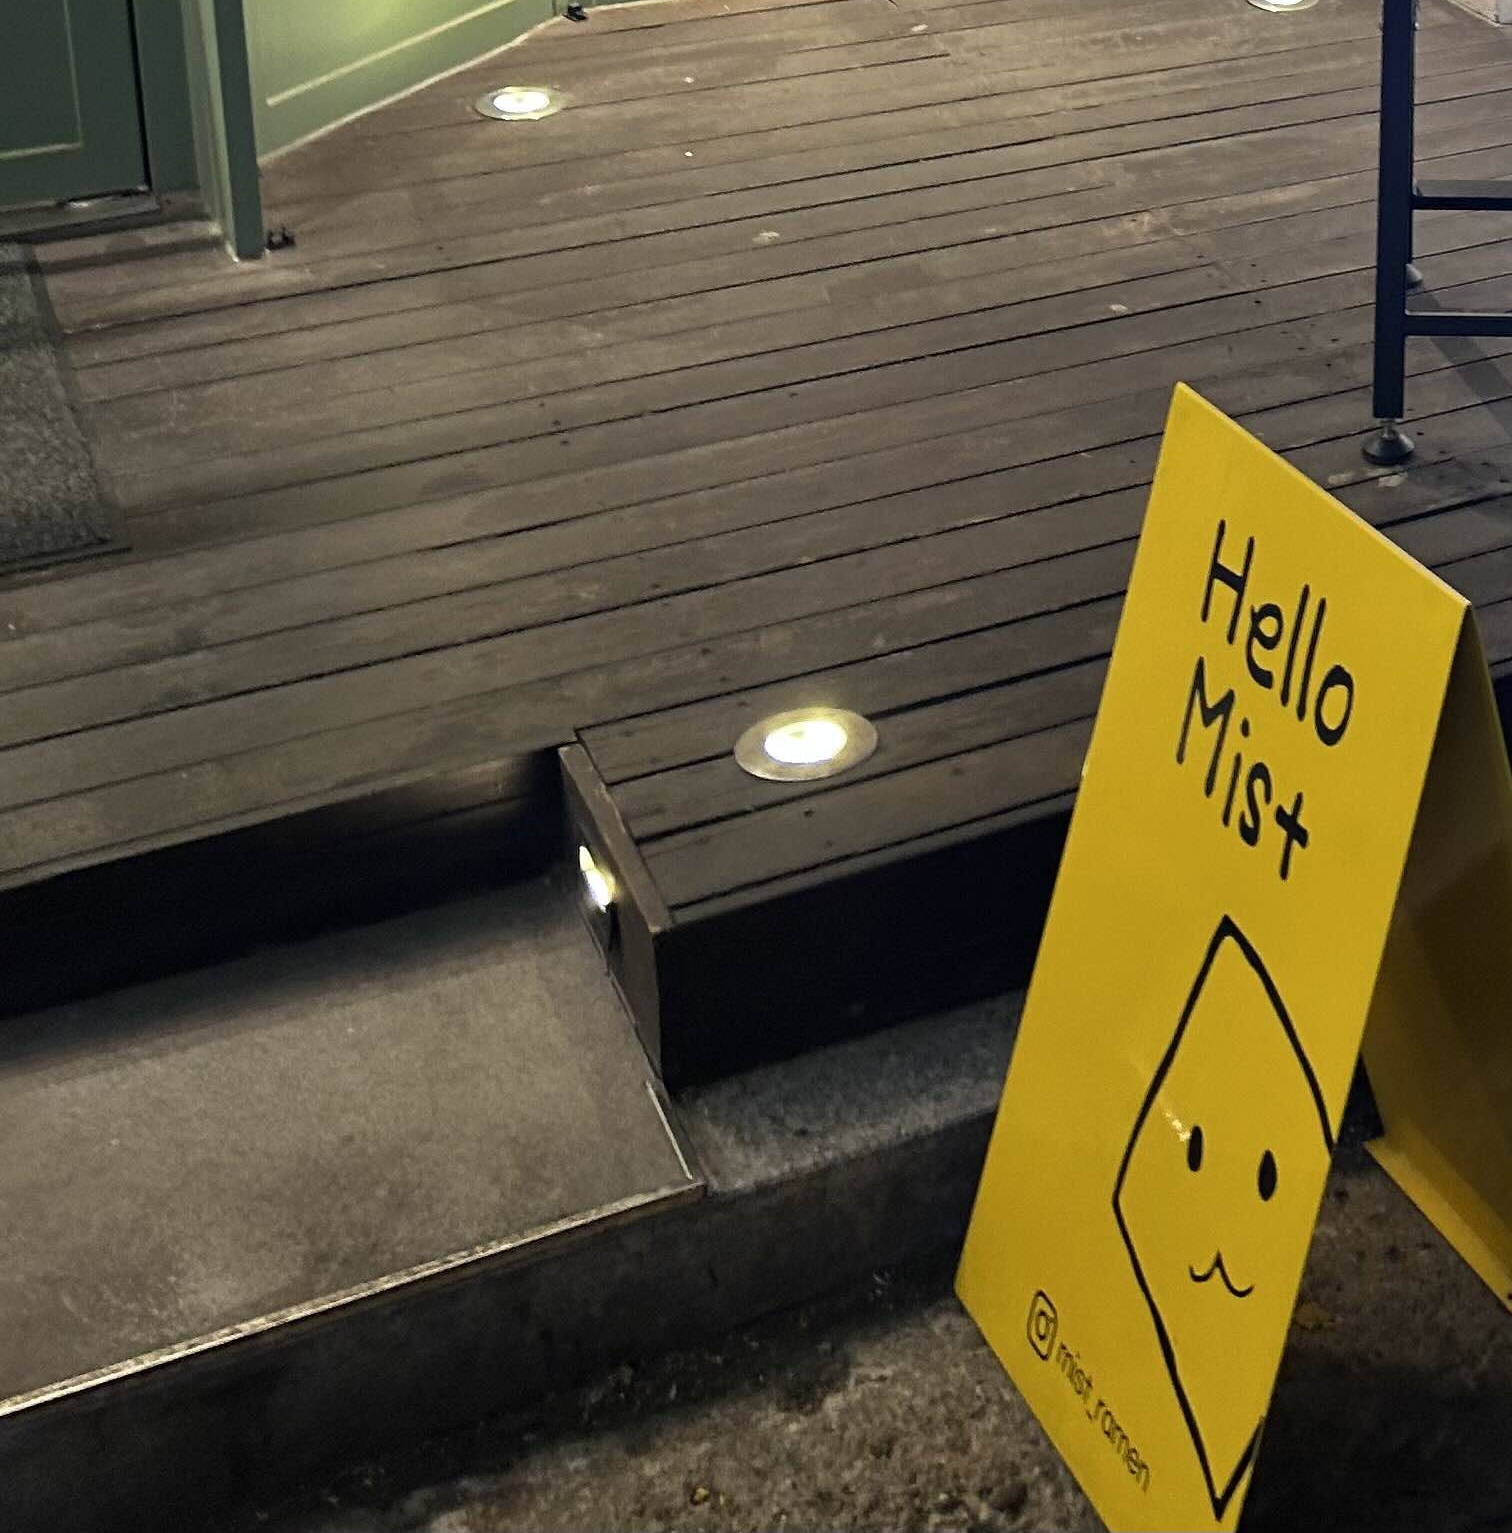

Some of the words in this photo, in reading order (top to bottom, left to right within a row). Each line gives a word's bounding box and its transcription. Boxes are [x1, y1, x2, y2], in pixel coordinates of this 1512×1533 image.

[1200, 518, 1355, 747] Hello
[1175, 655, 1310, 881] Mist
[1055, 1340, 1151, 1494] mist_ramen
